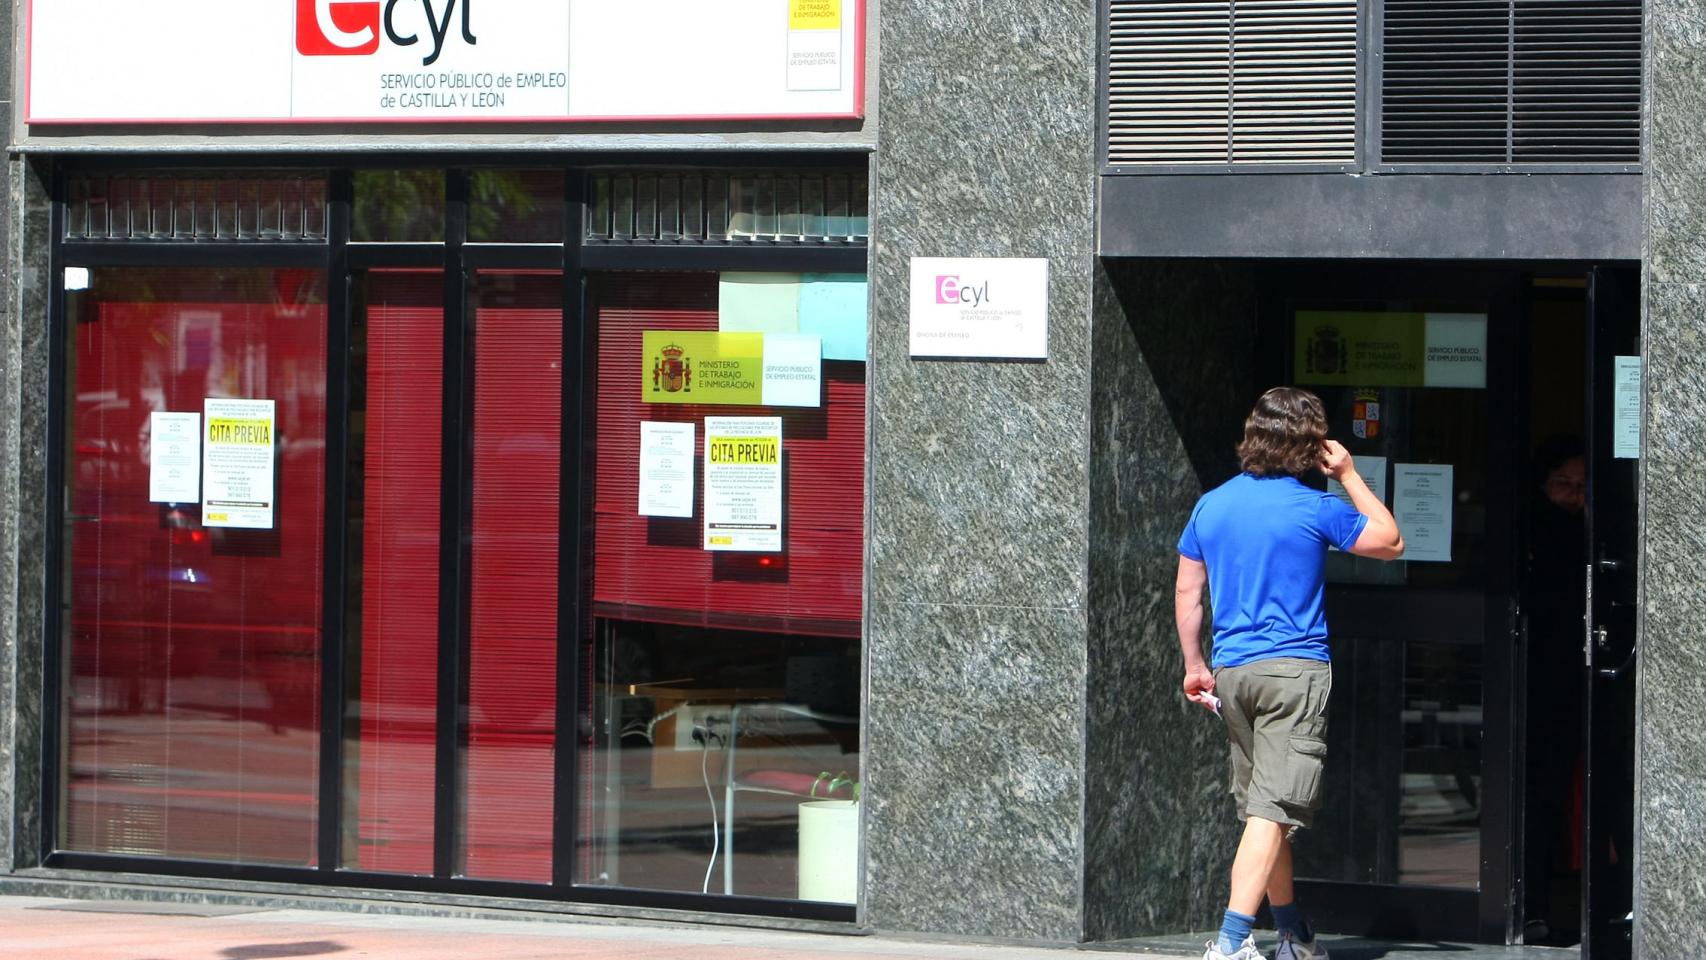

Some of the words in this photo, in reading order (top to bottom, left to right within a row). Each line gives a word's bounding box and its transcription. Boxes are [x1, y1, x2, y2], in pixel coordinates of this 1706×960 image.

[380, 74, 436, 89] SERVICIO
[439, 70, 493, 88] PÚBLICO
[497, 73, 512, 88] de
[516, 73, 566, 88] EMPLEO
[380, 94, 396, 108] de
[399, 93, 457, 108] CASTILLA
[460, 93, 468, 107] Y
[472, 89, 505, 107] LEÓN
[699, 360, 739, 369] MINISTERIO
[699, 370, 709, 378] DE
[710, 370, 742, 380] TRABAJO
[210, 424, 231, 442] CITA
[234, 425, 270, 444] PREVIA
[711, 443, 734, 462] CITA
[737, 443, 777, 463] PREVIA
